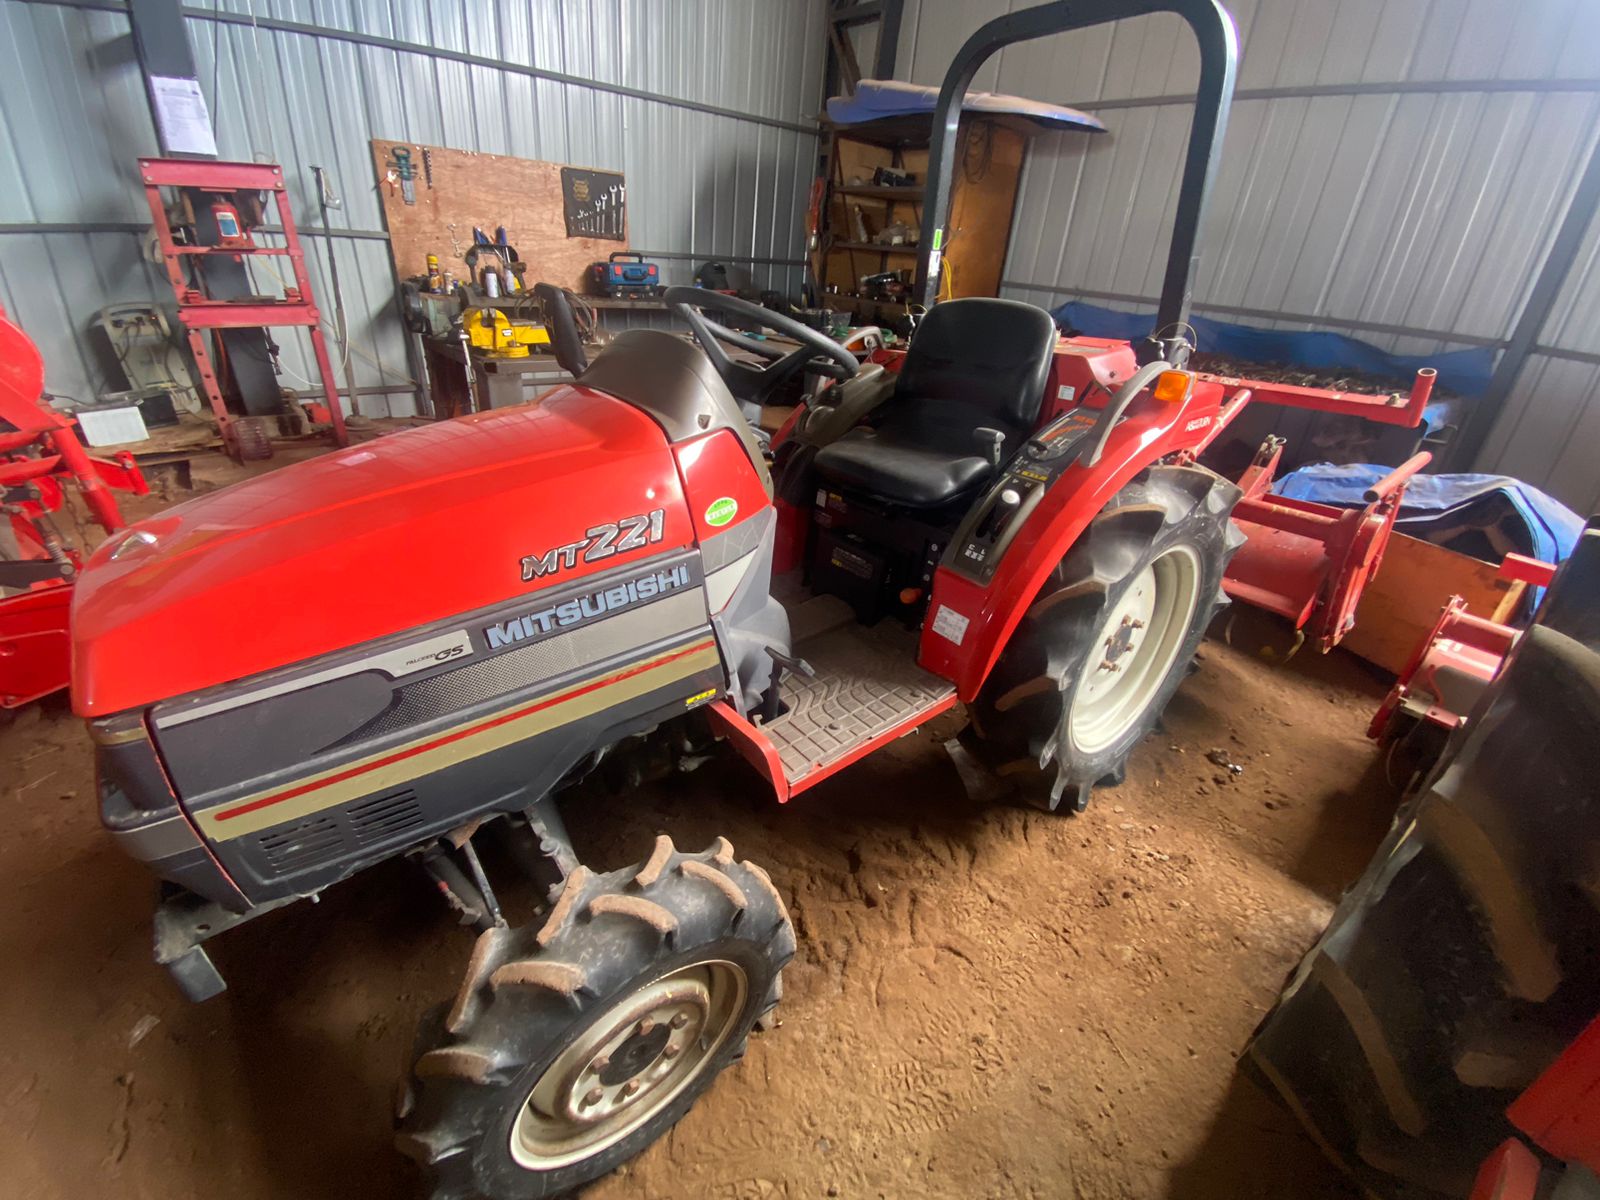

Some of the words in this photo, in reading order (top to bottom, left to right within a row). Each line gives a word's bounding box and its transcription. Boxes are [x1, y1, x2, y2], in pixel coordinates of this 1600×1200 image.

[520, 508, 665, 581] MT221
[485, 563, 691, 650] MITSUBISHI
[435, 644, 464, 661] GS
